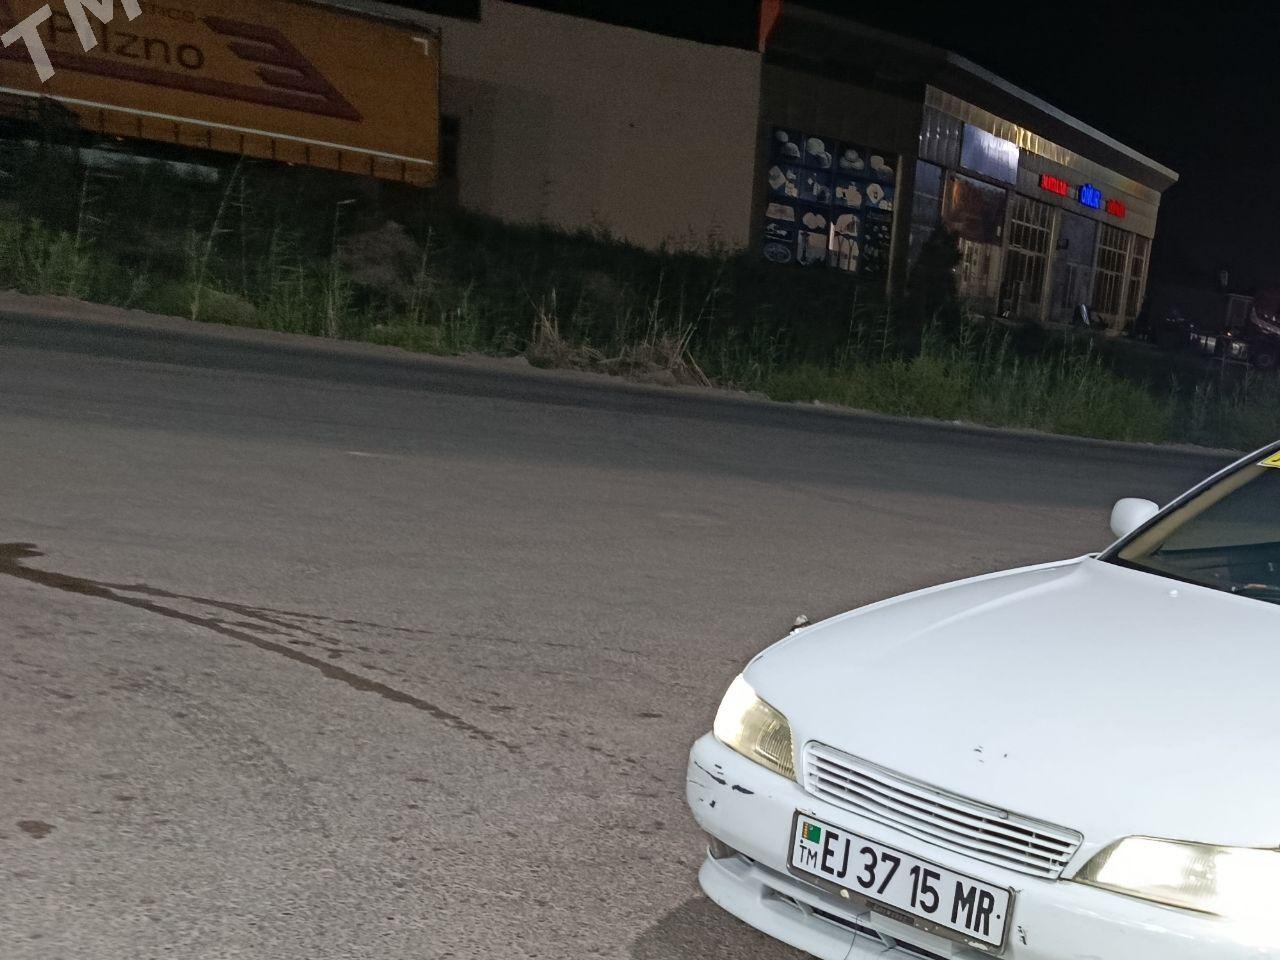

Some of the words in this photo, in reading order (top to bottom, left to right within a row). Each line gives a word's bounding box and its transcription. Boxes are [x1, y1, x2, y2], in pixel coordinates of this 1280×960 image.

[48, 10, 204, 69] Plzno
[799, 845, 818, 868] TM
[820, 830, 851, 879] EJ
[856, 846, 902, 895] 37
[910, 865, 941, 914] 15
[951, 881, 995, 936] MR
